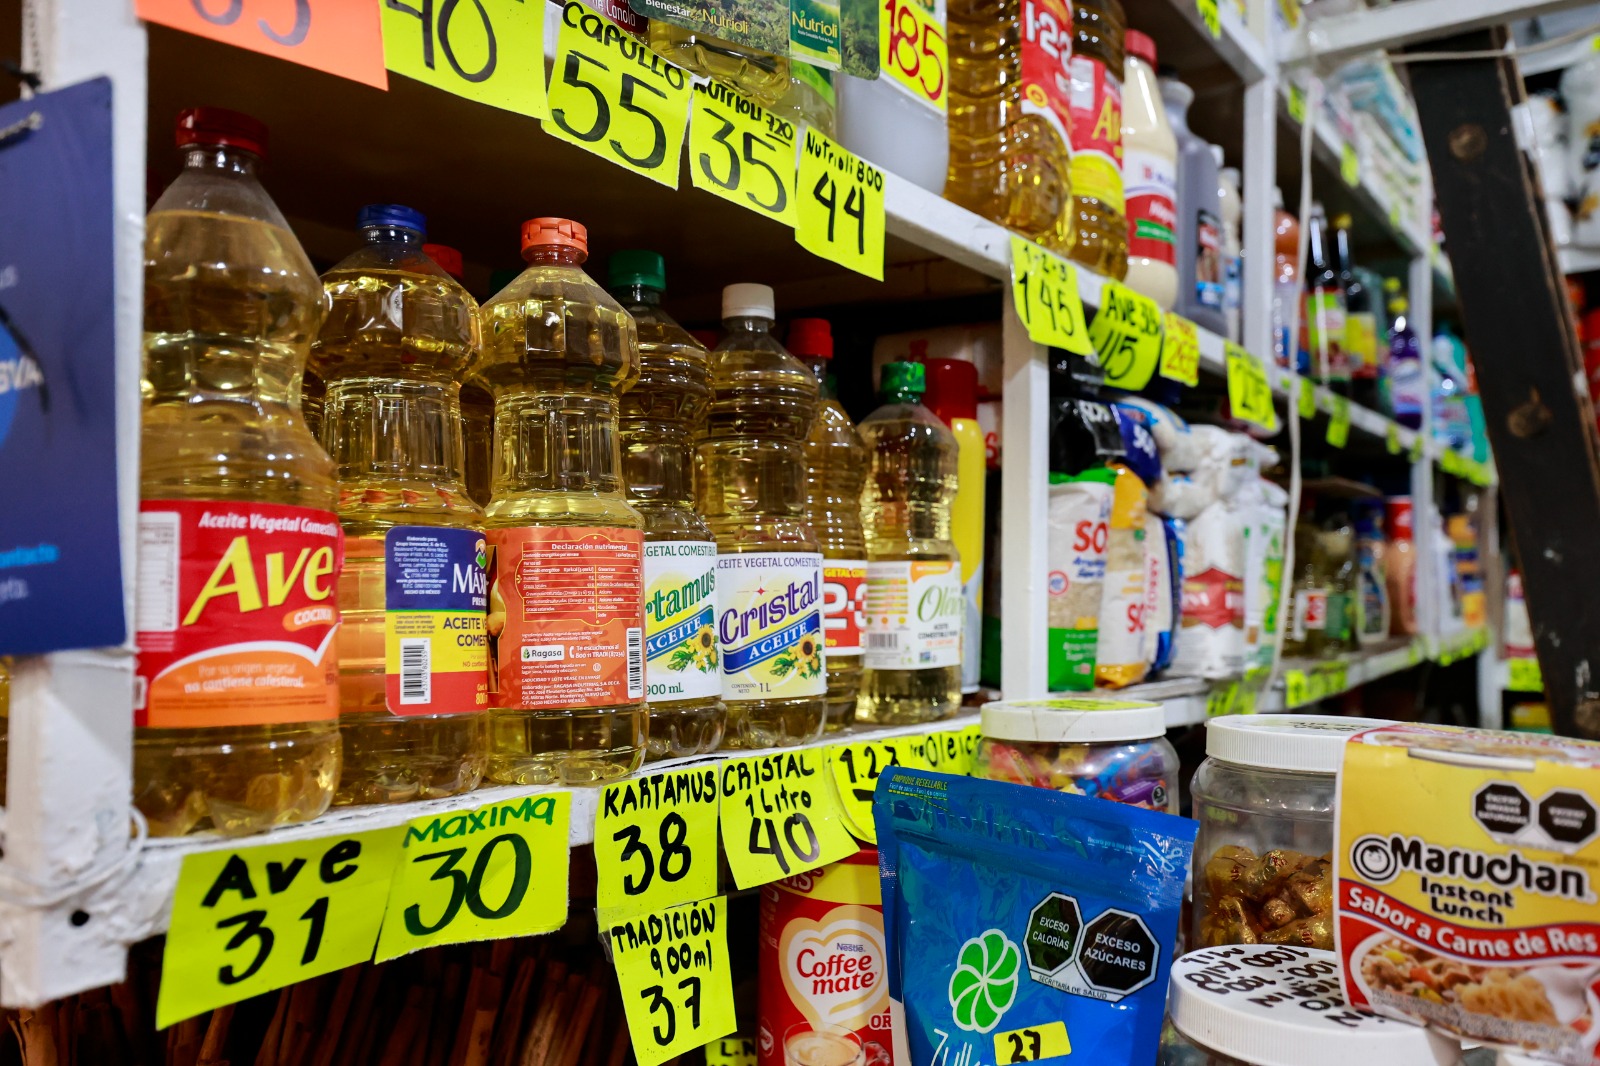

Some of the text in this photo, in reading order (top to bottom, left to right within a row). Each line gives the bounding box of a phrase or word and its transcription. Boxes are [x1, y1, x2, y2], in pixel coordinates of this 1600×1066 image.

[702, 8, 749, 34] Nutrioli
[792, 10, 838, 38] Nutrioli
[885, 0, 946, 101] 185
[552, 49, 667, 169] 55
[766, 113, 793, 141] 720
[699, 107, 787, 213] 35
[856, 161, 883, 193] 800
[813, 171, 864, 256] 44
[1018, 272, 1074, 337] 145
[198, 512, 247, 529] Aceite
[250, 513, 300, 534] Vegetal
[595, 543, 628, 551] nutrimental
[744, 557, 782, 569] VEGETAL
[784, 556, 820, 568] COMESTIBLE
[182, 535, 334, 626] Ave
[443, 617, 480, 630] ACEITE
[720, 570, 818, 645] Cristal
[647, 616, 702, 656] ACEITE
[749, 621, 808, 660] ACEITE
[531, 649, 562, 658] Ragasa
[203, 676, 251, 692] contiene
[669, 682, 684, 694] mL
[722, 753, 814, 797] CRISTAL
[915, 777, 948, 791] RESELLABLE
[604, 770, 716, 819] KARTAMUS
[613, 811, 692, 896] 38
[749, 812, 820, 876] 40
[201, 839, 361, 908] Ave
[1391, 835, 1584, 898] Maruchan
[404, 832, 532, 937] 30
[1421, 875, 1514, 908] Instant
[611, 901, 716, 954] TRADICIÓN
[1039, 916, 1070, 933] EXCESO
[1348, 887, 1598, 957] Sabor a Carne de Res
[1430, 897, 1504, 924] Lunch
[216, 896, 329, 987] 31
[1032, 931, 1070, 951] CALORÍAS
[1095, 932, 1141, 954] EXCESO
[796, 948, 872, 978] Coffee
[1084, 946, 1146, 972] AZÚCARES
[812, 971, 875, 995] mate
[1038, 975, 1108, 1000] SECRETARÍA DE SALUD
[640, 976, 701, 1047] 37
[1008, 1029, 1041, 1064] 27
